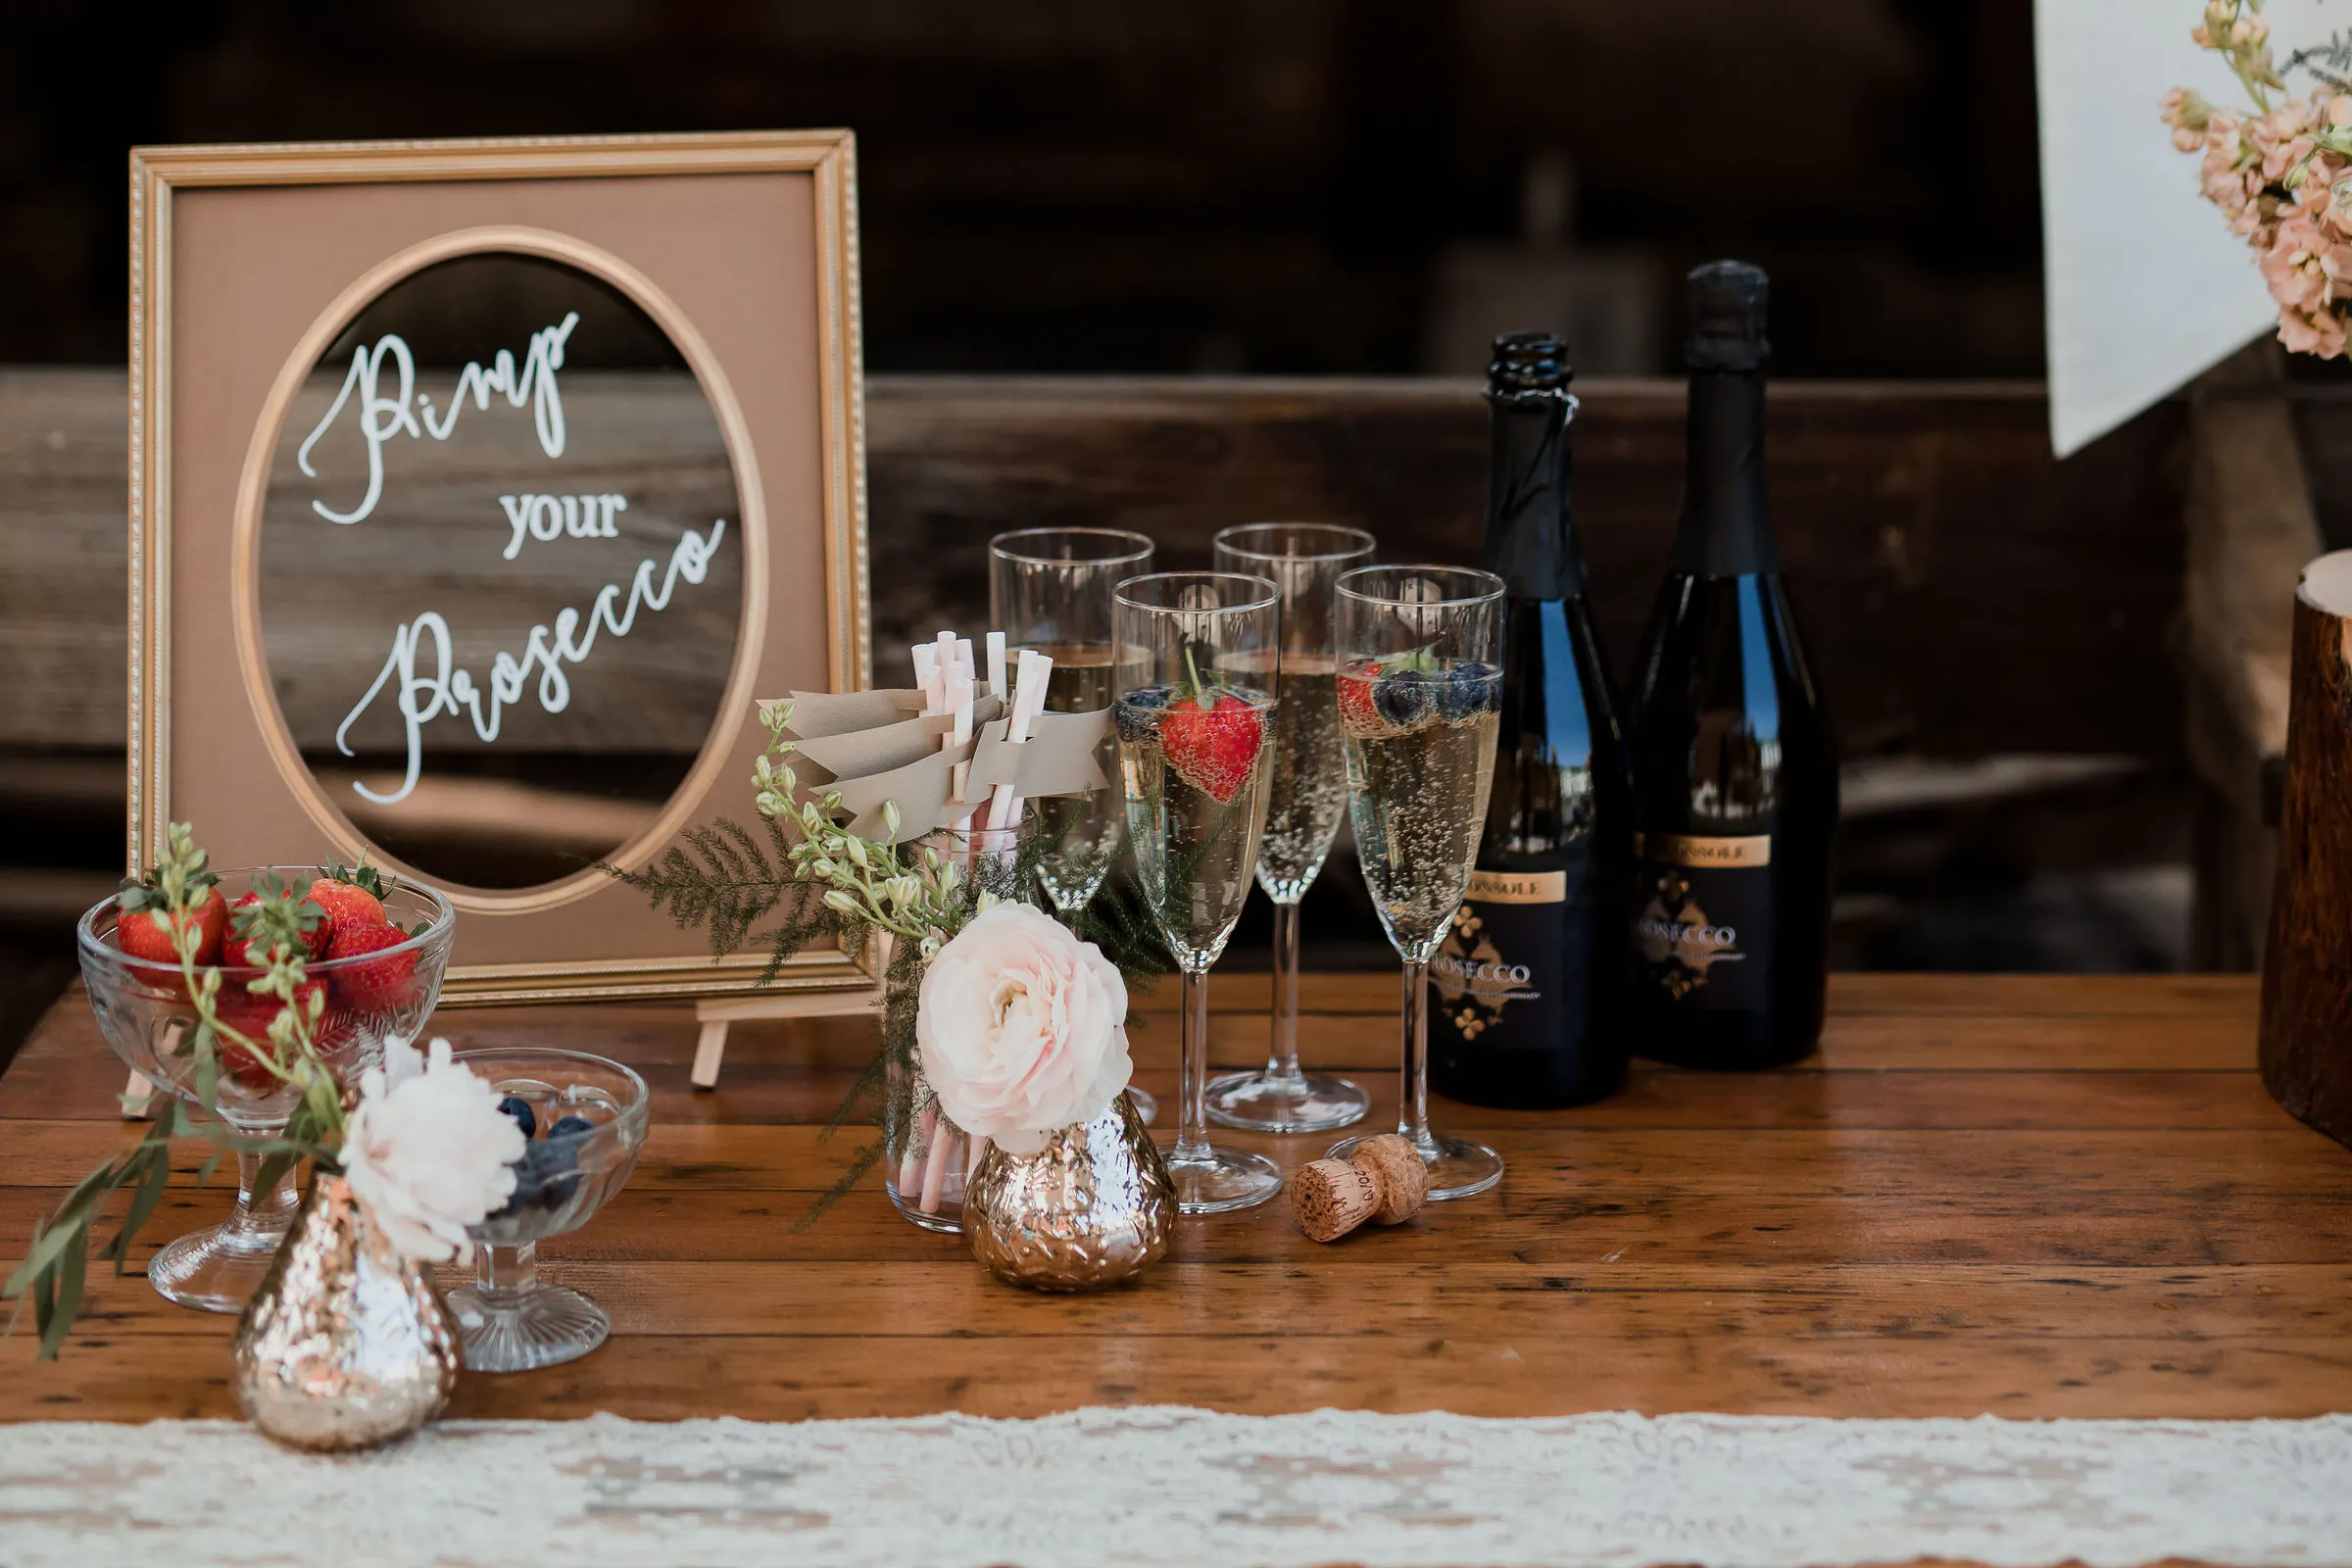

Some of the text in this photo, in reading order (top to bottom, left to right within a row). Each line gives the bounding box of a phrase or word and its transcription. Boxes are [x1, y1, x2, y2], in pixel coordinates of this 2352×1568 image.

[297, 312, 579, 524] Pimp
[499, 493, 627, 560] your
[335, 518, 726, 804] Prosecco
